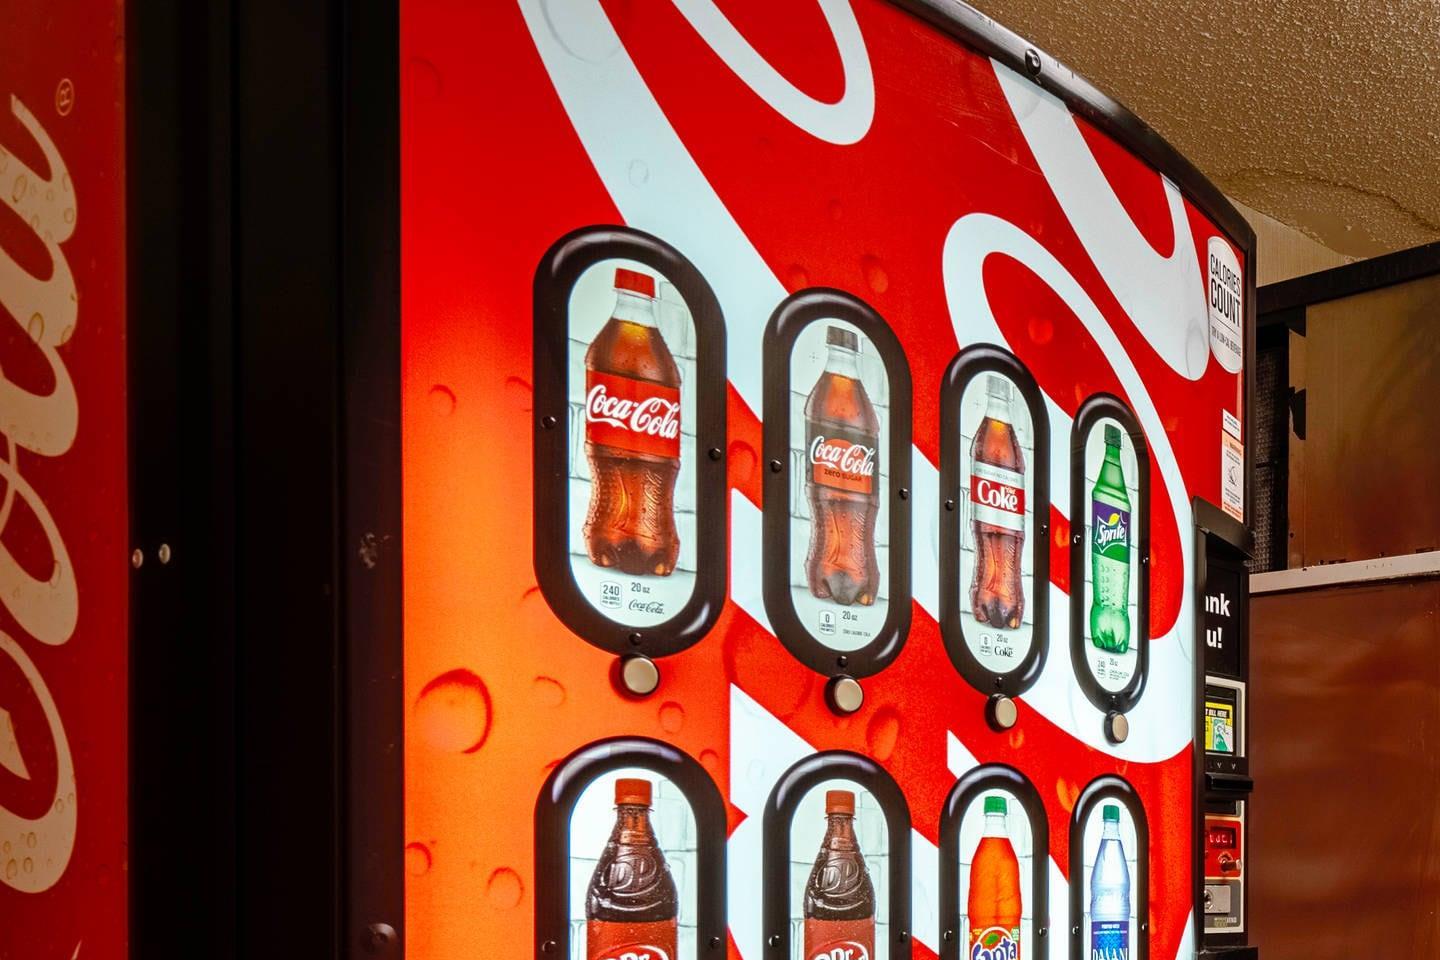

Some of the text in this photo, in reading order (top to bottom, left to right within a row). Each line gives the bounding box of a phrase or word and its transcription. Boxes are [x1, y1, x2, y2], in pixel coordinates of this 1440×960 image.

[1210, 253, 1241, 297] CALORIES
[1211, 278, 1240, 327] COUNT
[586, 384, 680, 439] Coca-Cola
[810, 435, 876, 476] Coca-Cola
[977, 480, 1018, 512] Coke
[1097, 524, 1125, 547] Sprite
[602, 584, 620, 596] 240
[631, 582, 642, 593] 20
[842, 610, 851, 621] 20
